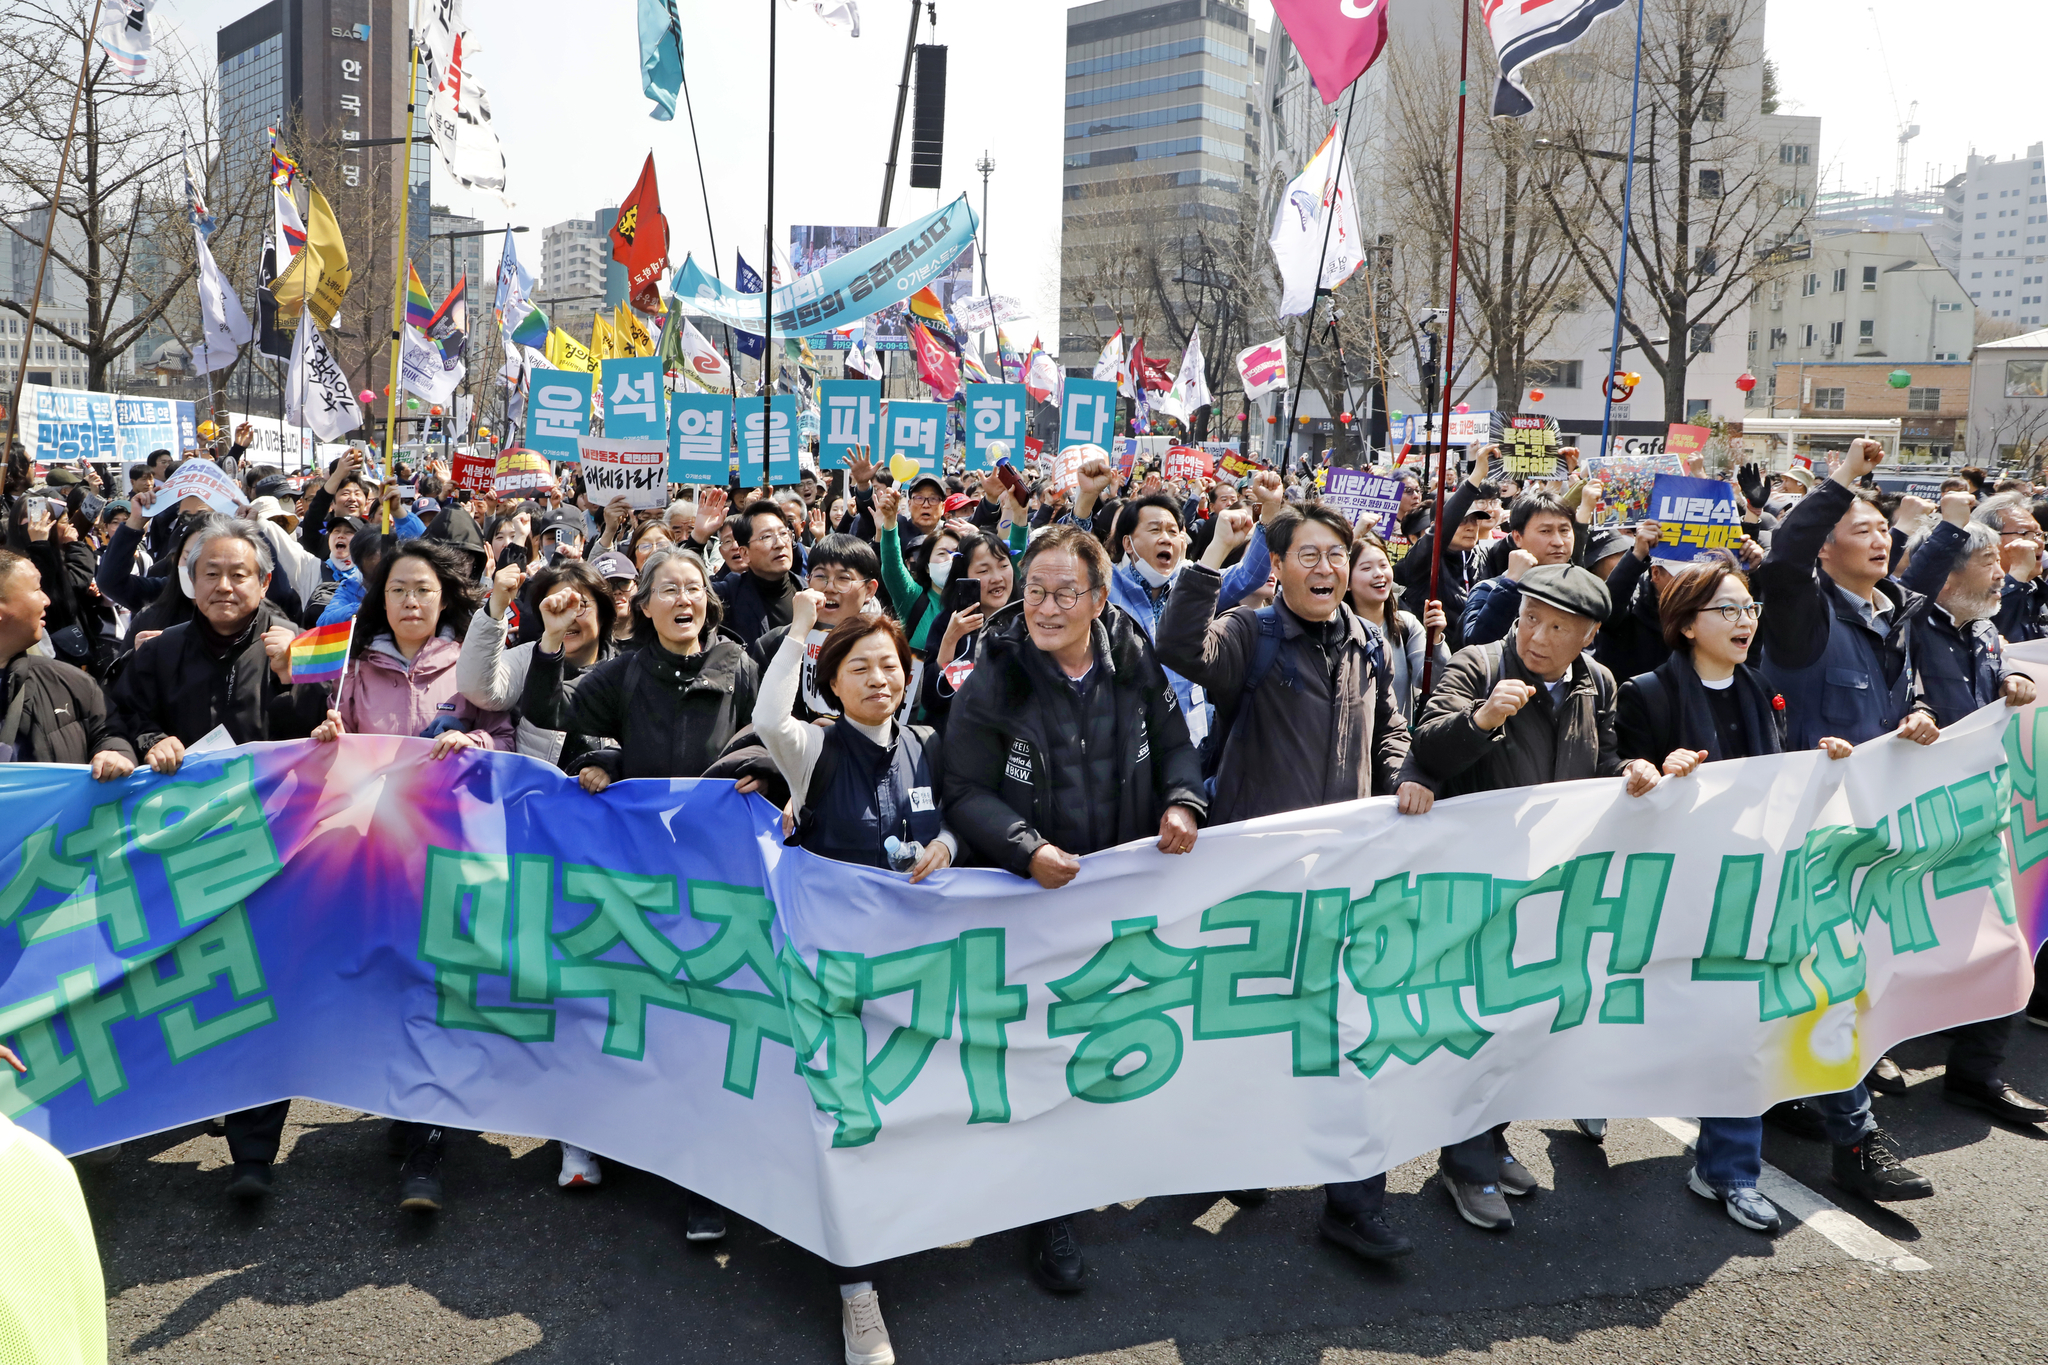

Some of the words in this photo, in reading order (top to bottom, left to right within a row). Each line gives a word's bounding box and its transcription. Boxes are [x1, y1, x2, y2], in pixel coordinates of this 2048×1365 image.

[772, 289, 846, 332] 국민의
[848, 216, 952, 303] 승리입니다
[907, 243, 959, 286] 기본소득당
[565, 342, 599, 372] 정의당
[534, 385, 584, 439] 윤
[609, 372, 657, 422] 석
[1065, 393, 1109, 443] 다
[36, 423, 117, 460] 민생회복
[678, 408, 724, 462] 열
[744, 411, 791, 464] 을
[827, 395, 876, 446] 파
[893, 417, 937, 468] 면
[972, 397, 1021, 449] 한
[1514, 418, 1541, 428] 내란수괴
[582, 448, 619, 463] 내란동조
[623, 453, 660, 463] 국민의힘
[584, 465, 664, 491] 해체하라!
[1167, 453, 1205, 468] 새봄에는
[1503, 455, 1557, 474] 파면하라
[1331, 474, 1400, 499] 내란세력
[1010, 765, 1030, 780] BKW
[1046, 851, 1676, 1105] 승리했다!
